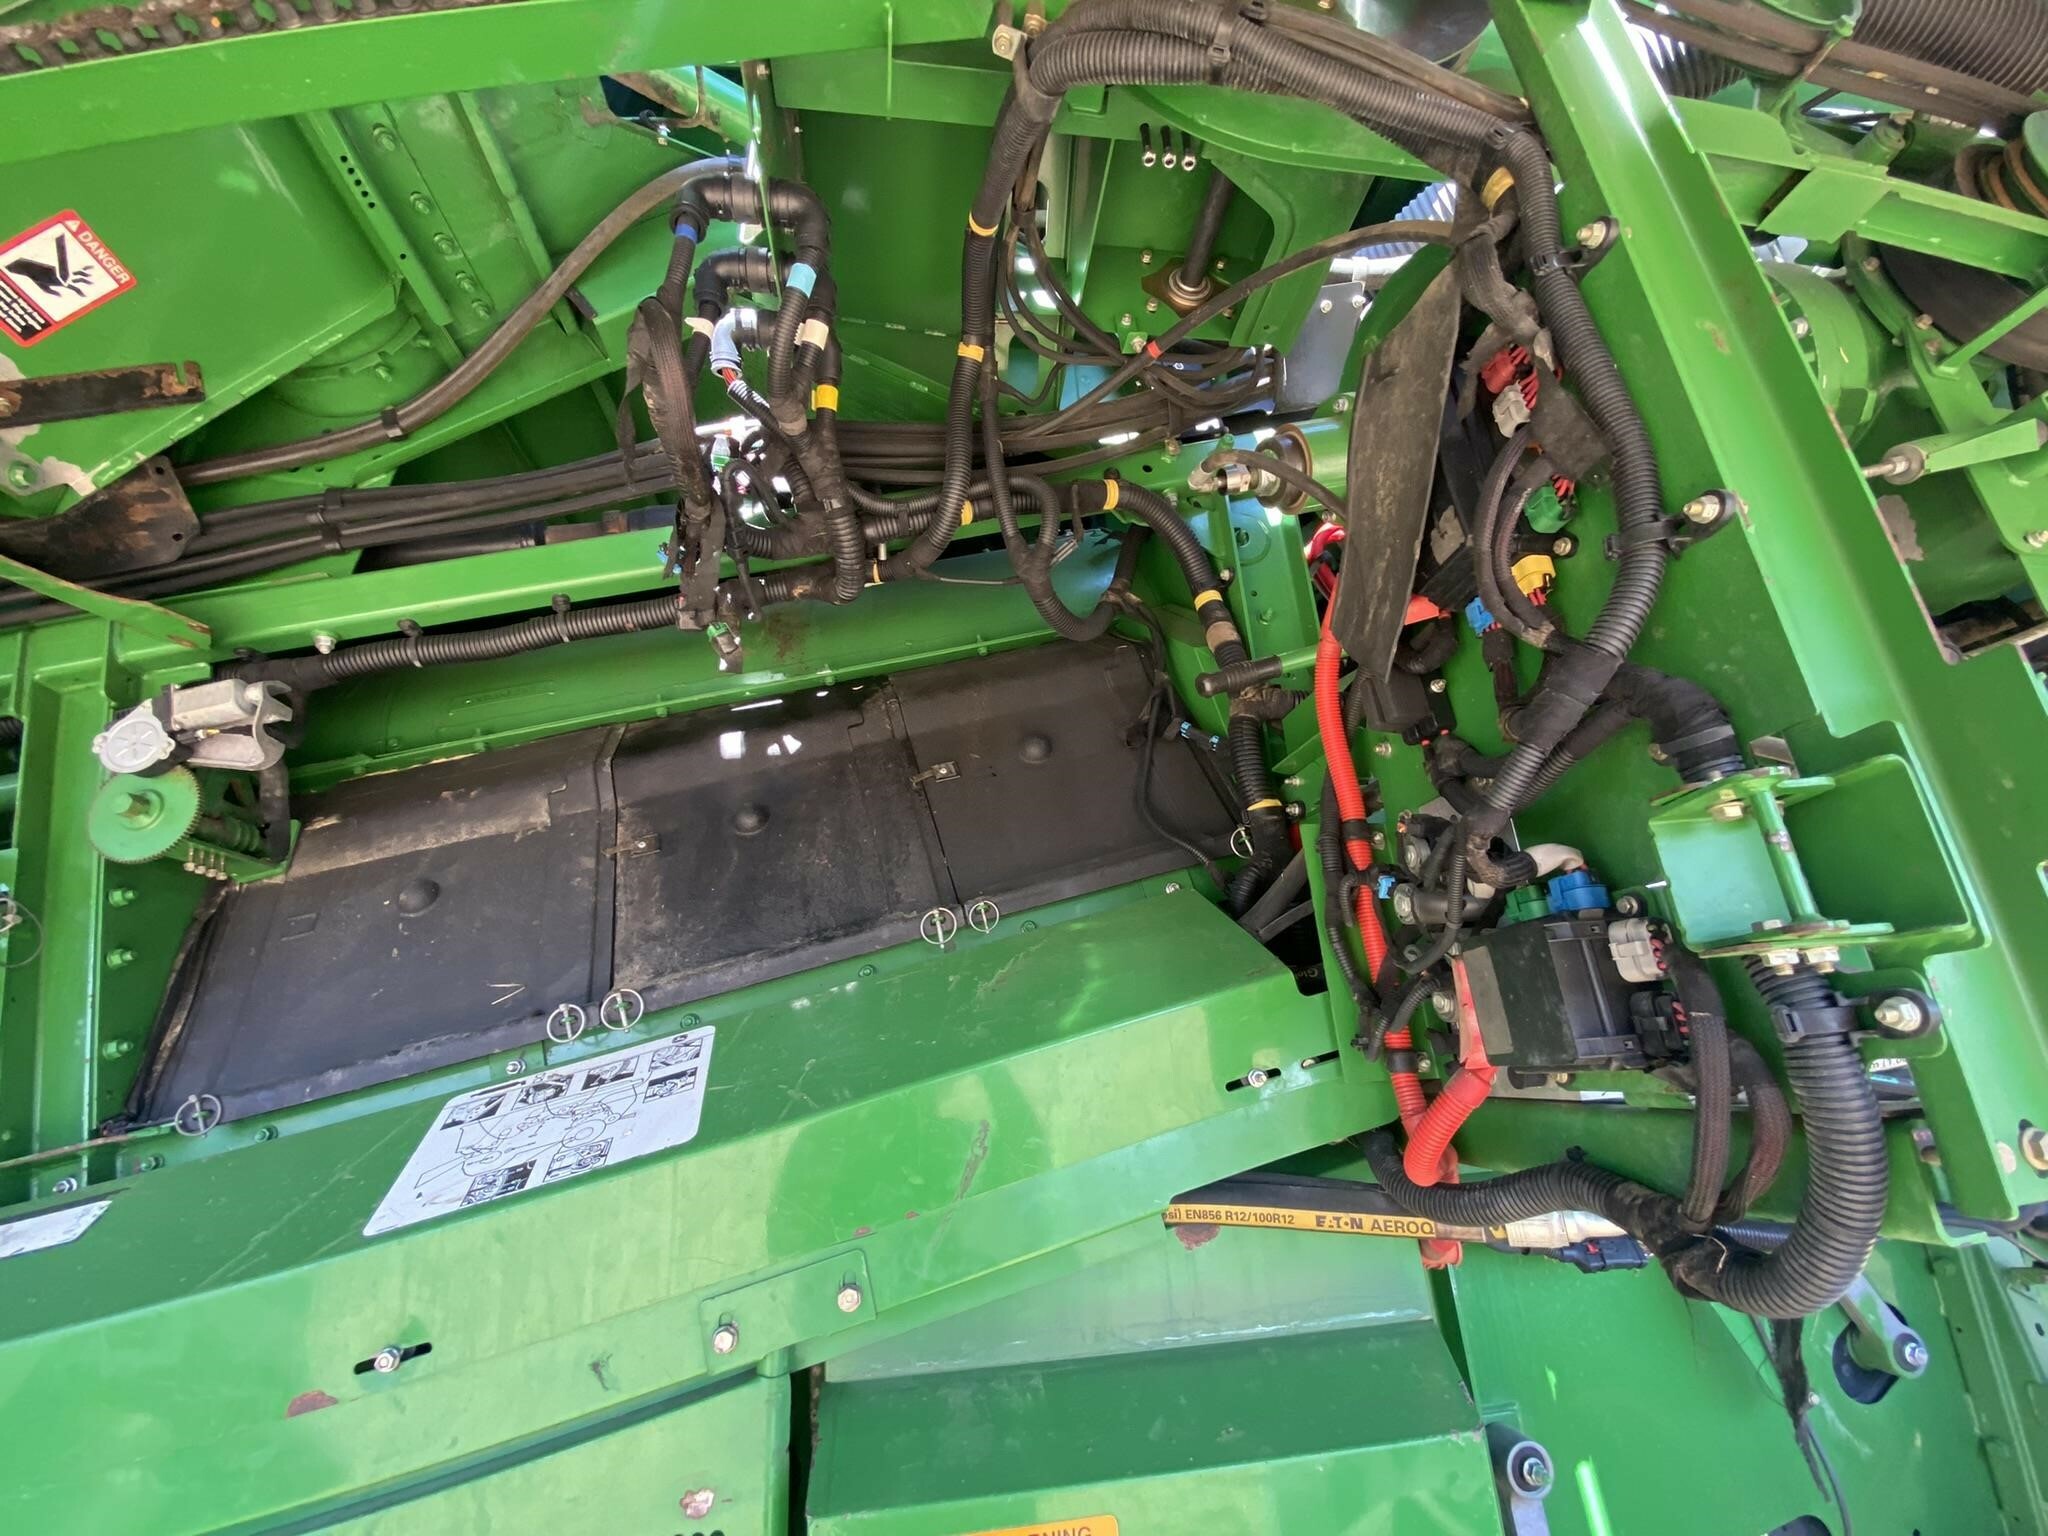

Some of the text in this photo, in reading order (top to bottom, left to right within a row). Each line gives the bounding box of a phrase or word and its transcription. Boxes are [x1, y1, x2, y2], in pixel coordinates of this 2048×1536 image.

[77, 230, 131, 284] DANGER
[1185, 1208, 1222, 1222] EN856
[1225, 1211, 1296, 1225] R12/100R12
[1370, 1219, 1435, 1235] AEROQ
